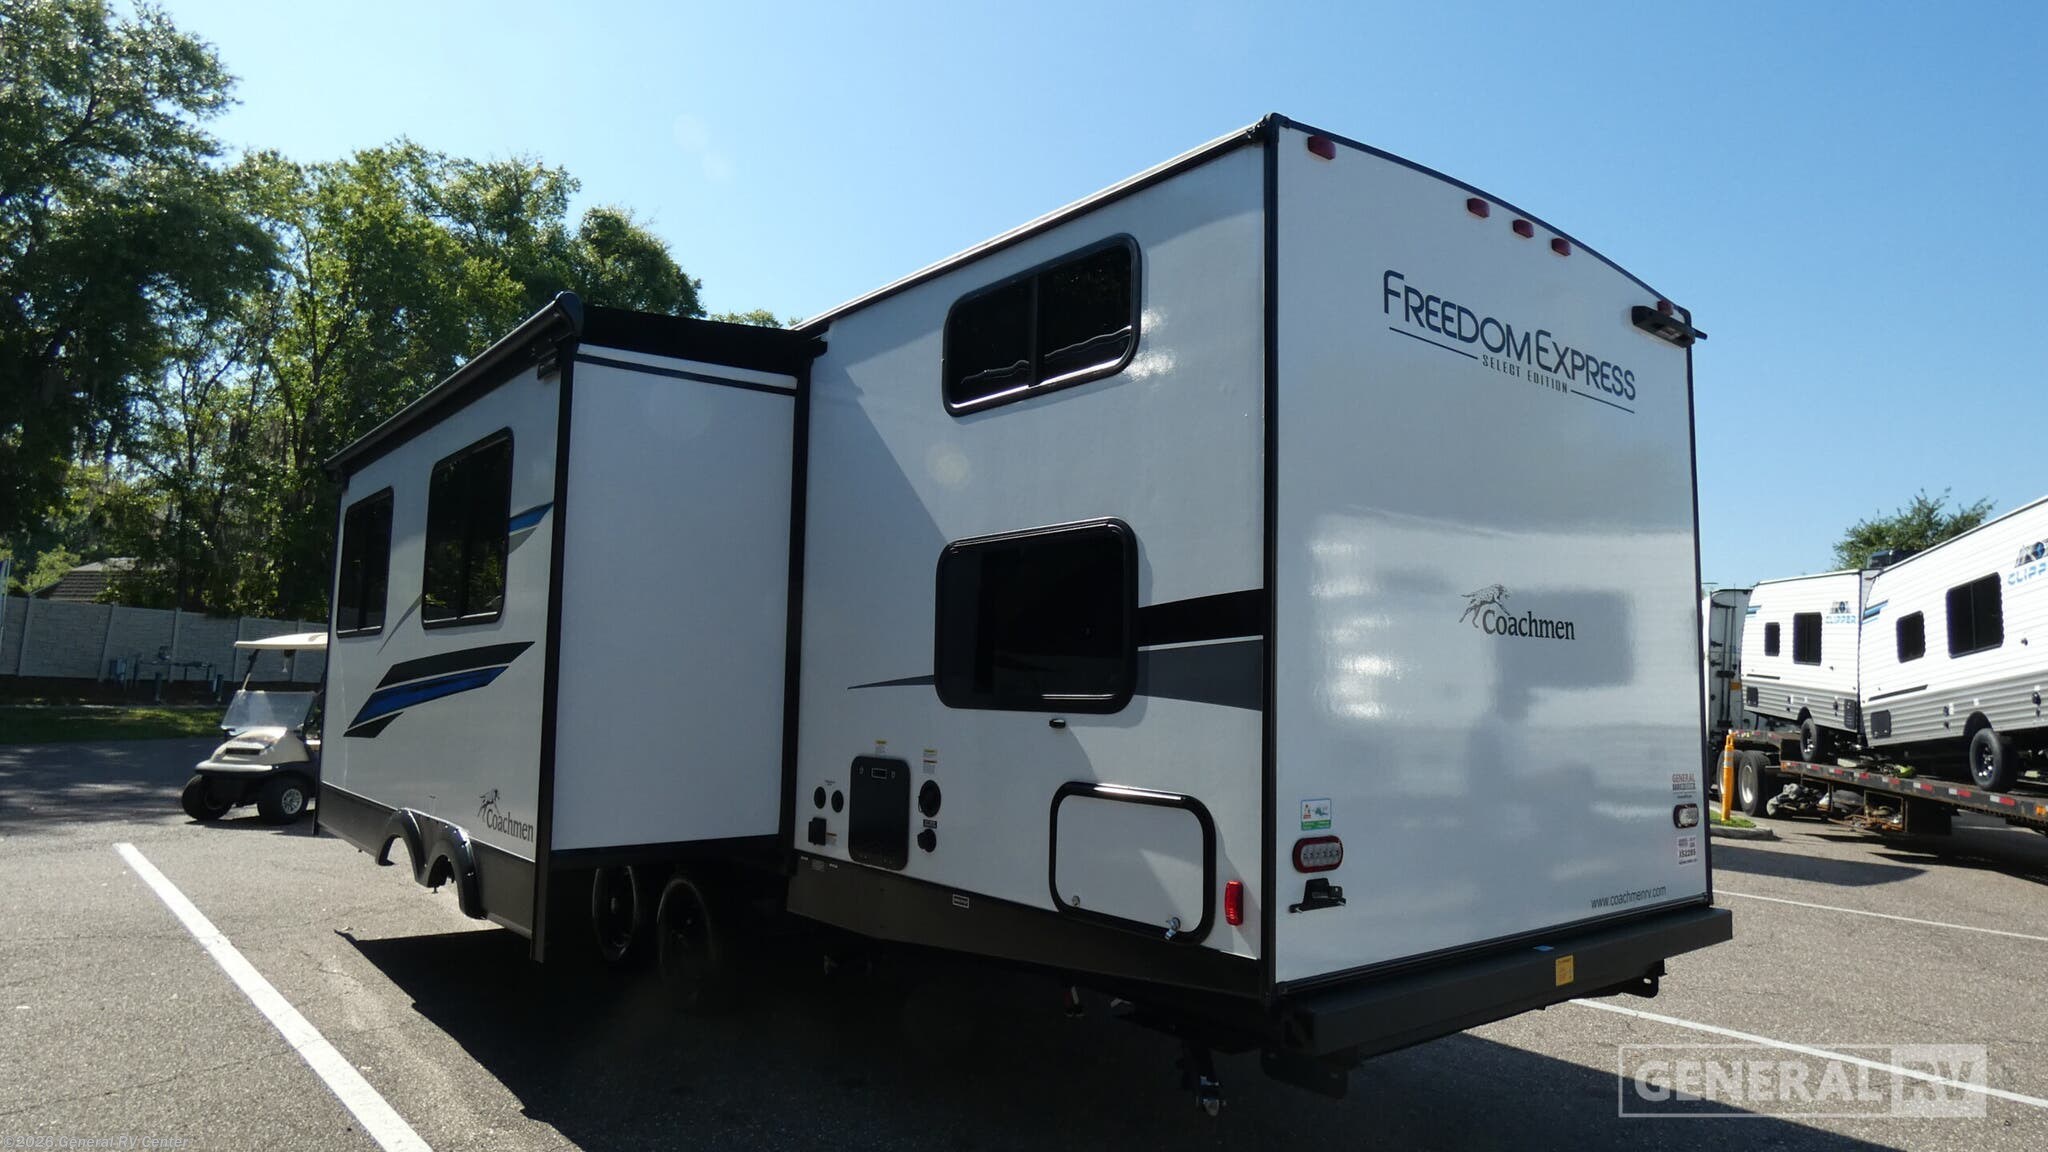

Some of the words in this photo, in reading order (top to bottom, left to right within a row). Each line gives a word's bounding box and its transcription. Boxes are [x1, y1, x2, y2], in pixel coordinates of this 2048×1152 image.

[1482, 353, 1521, 378] SELECT
[1527, 369, 1568, 394] EDITION
[1482, 609, 1576, 641] Coachmen
[486, 808, 534, 843] Coachmen
[1590, 885, 1668, 909] www.coachmenrv.com
